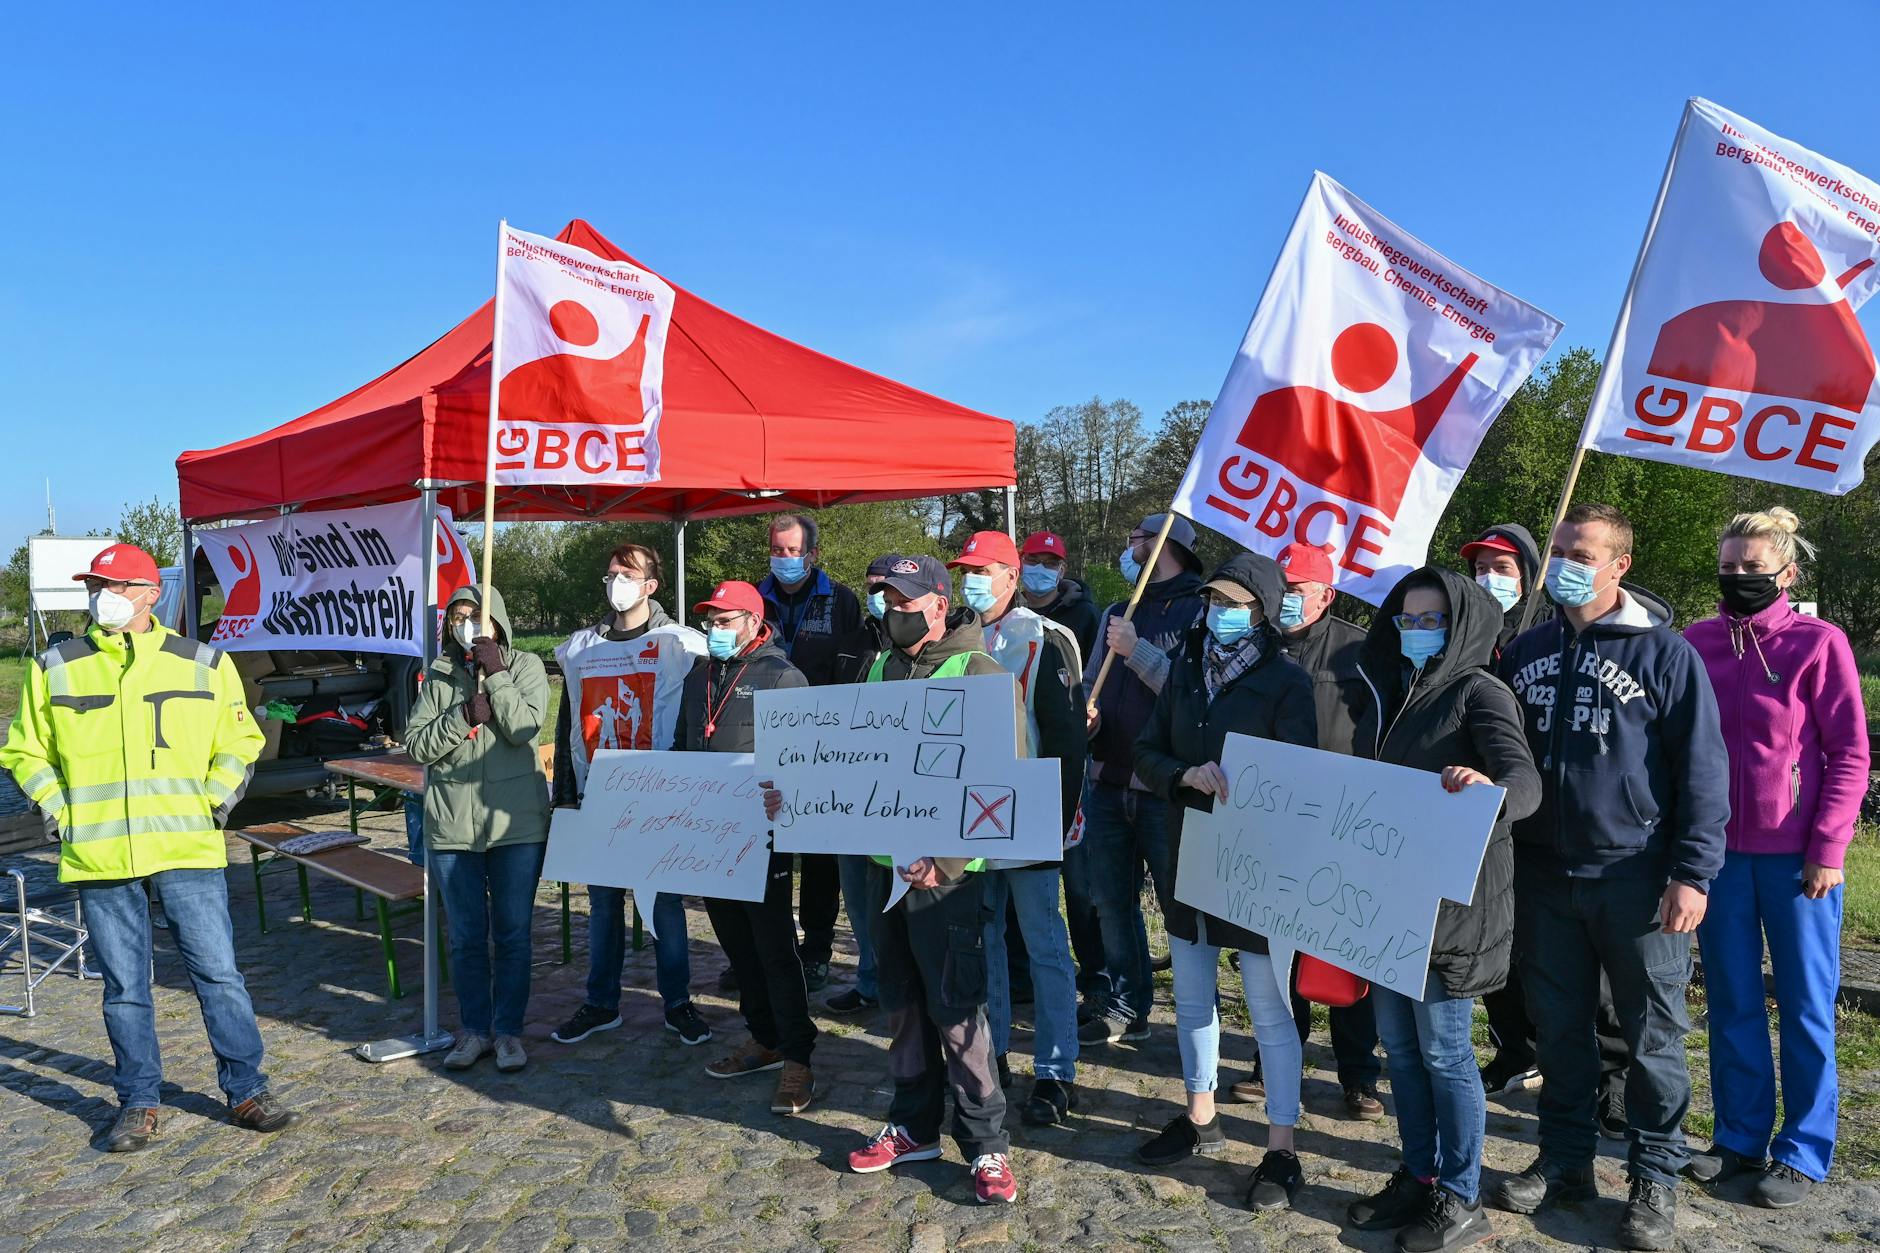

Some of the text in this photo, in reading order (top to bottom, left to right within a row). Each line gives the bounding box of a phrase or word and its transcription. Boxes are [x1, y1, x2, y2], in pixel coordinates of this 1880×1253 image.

[1715, 142, 1880, 245] Bergbau, Ener
[611, 284, 655, 302] Energie
[1326, 230, 1496, 344] Bergbau, Chemie, Energie
[1333, 213, 1489, 316] Industriegewerkschaft
[295, 522, 357, 573] sind
[342, 521, 396, 566] im
[262, 576, 415, 640] Warnstreik
[759, 688, 909, 731] vereintes Land
[780, 790, 855, 828] gleiche
